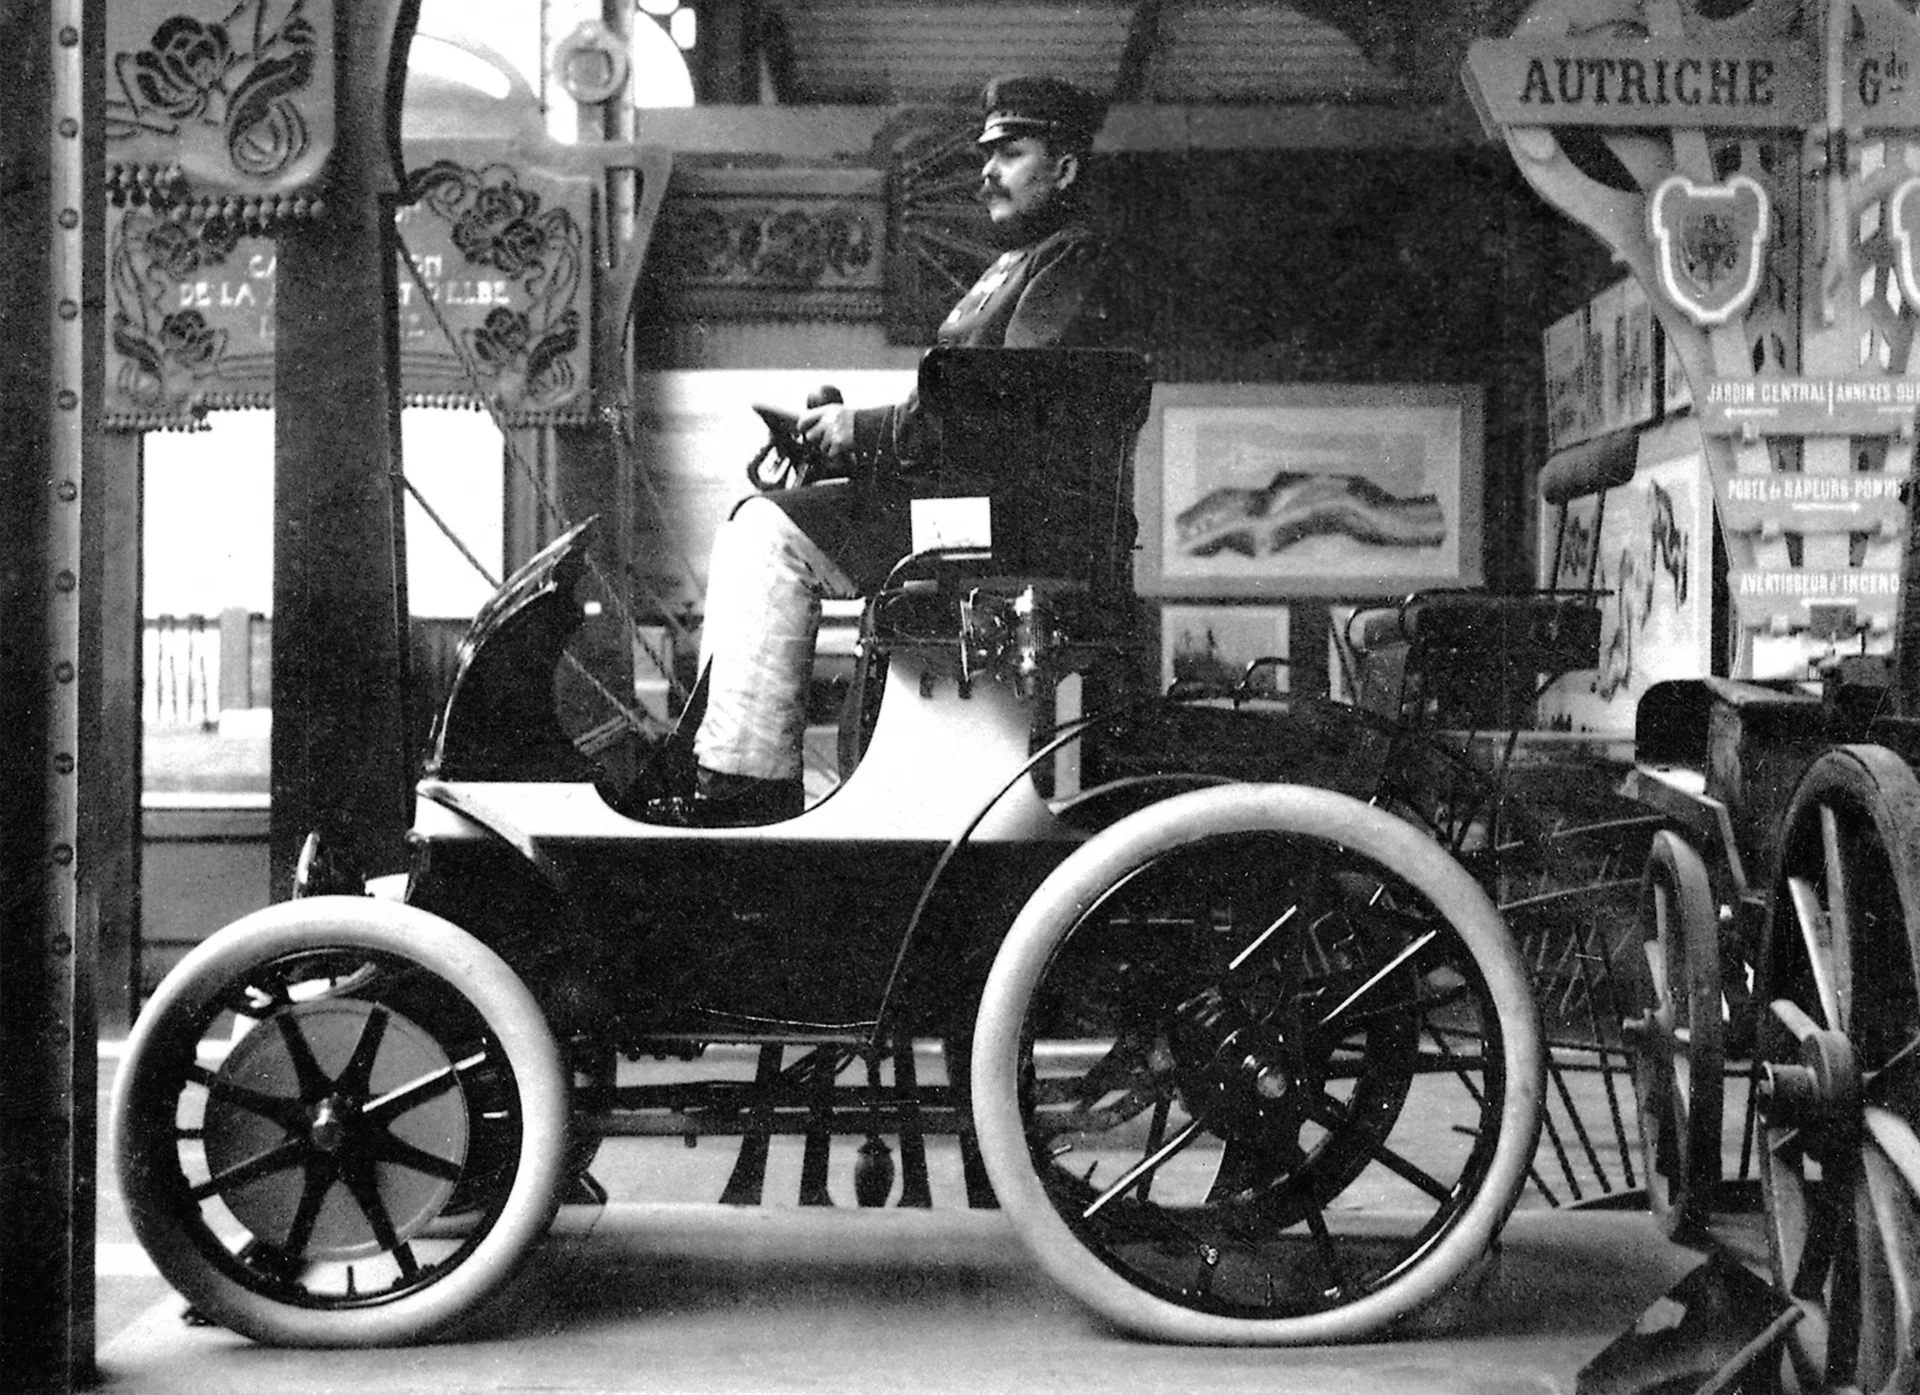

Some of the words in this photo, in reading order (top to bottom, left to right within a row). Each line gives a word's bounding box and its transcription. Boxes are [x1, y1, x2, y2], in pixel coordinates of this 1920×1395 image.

[1519, 58, 1775, 106] AUTRICHE
[179, 281, 212, 306] DE
[219, 281, 256, 306] LA
[1707, 383, 1755, 403] JARDIN
[1761, 383, 1826, 403] CENTRAL
[1836, 383, 1891, 402] ANNEXES
[1784, 479, 1850, 500] SAPEURS
[1740, 574, 1828, 596] AVERTISSEUR
